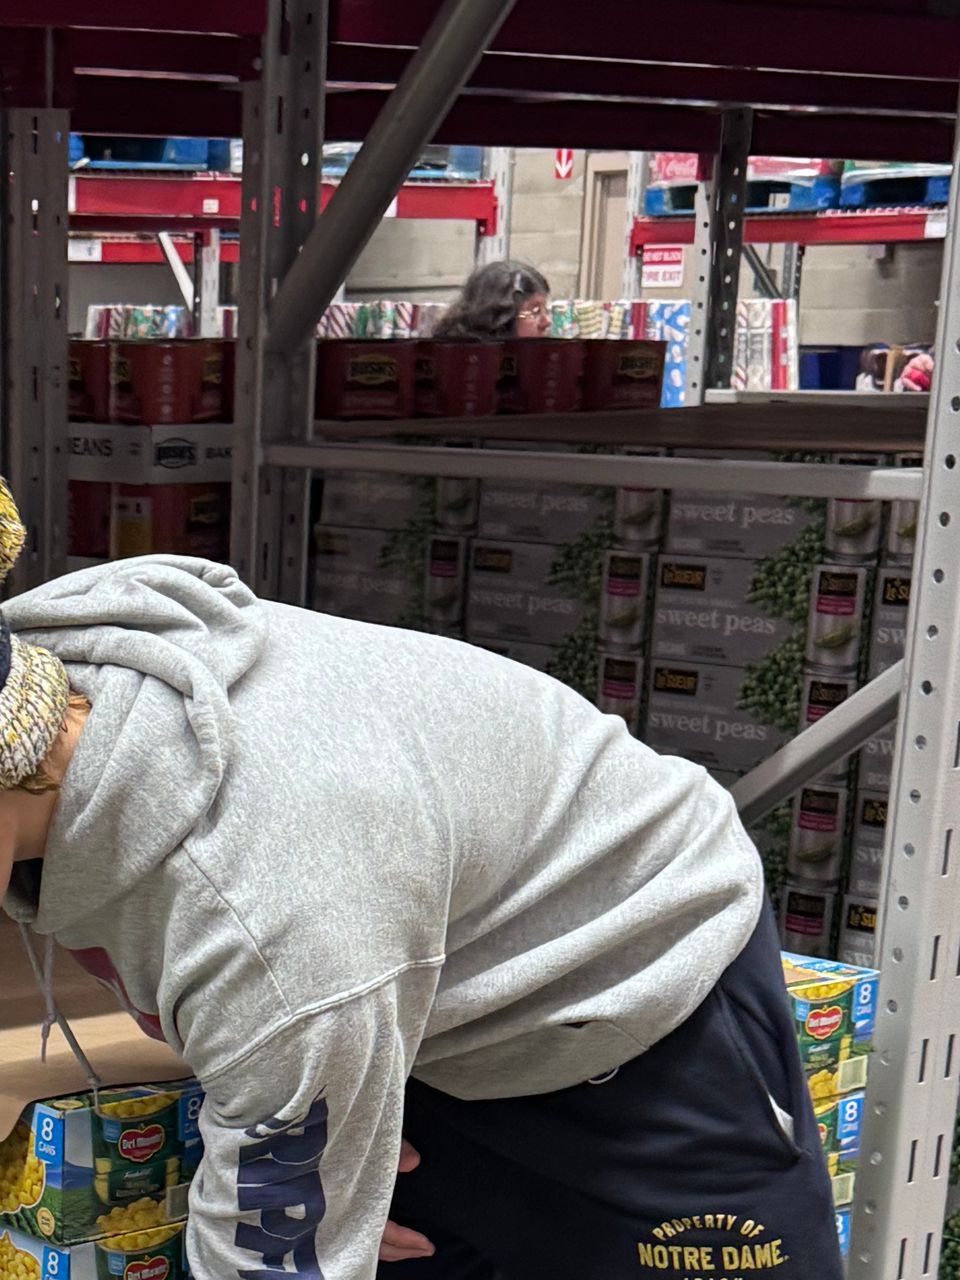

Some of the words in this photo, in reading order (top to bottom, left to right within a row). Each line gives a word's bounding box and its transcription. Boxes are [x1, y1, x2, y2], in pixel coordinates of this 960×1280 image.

[671, 502, 735, 523] sweet
[740, 506, 794, 528] peas
[656, 608, 721, 630] sweet
[723, 612, 776, 635] peas
[649, 711, 714, 735] sweet
[714, 718, 767, 743] peas
[859, 983, 873, 1005] 8
[844, 1100, 858, 1122] 8
[42, 1117, 55, 1142] 8
[651, 1214, 738, 1241] PROPERTY
[740, 1219, 765, 1239] OF
[46, 1252, 59, 1276] 8
[637, 1242, 716, 1271] NOTRE
[721, 1239, 785, 1271] DAME
